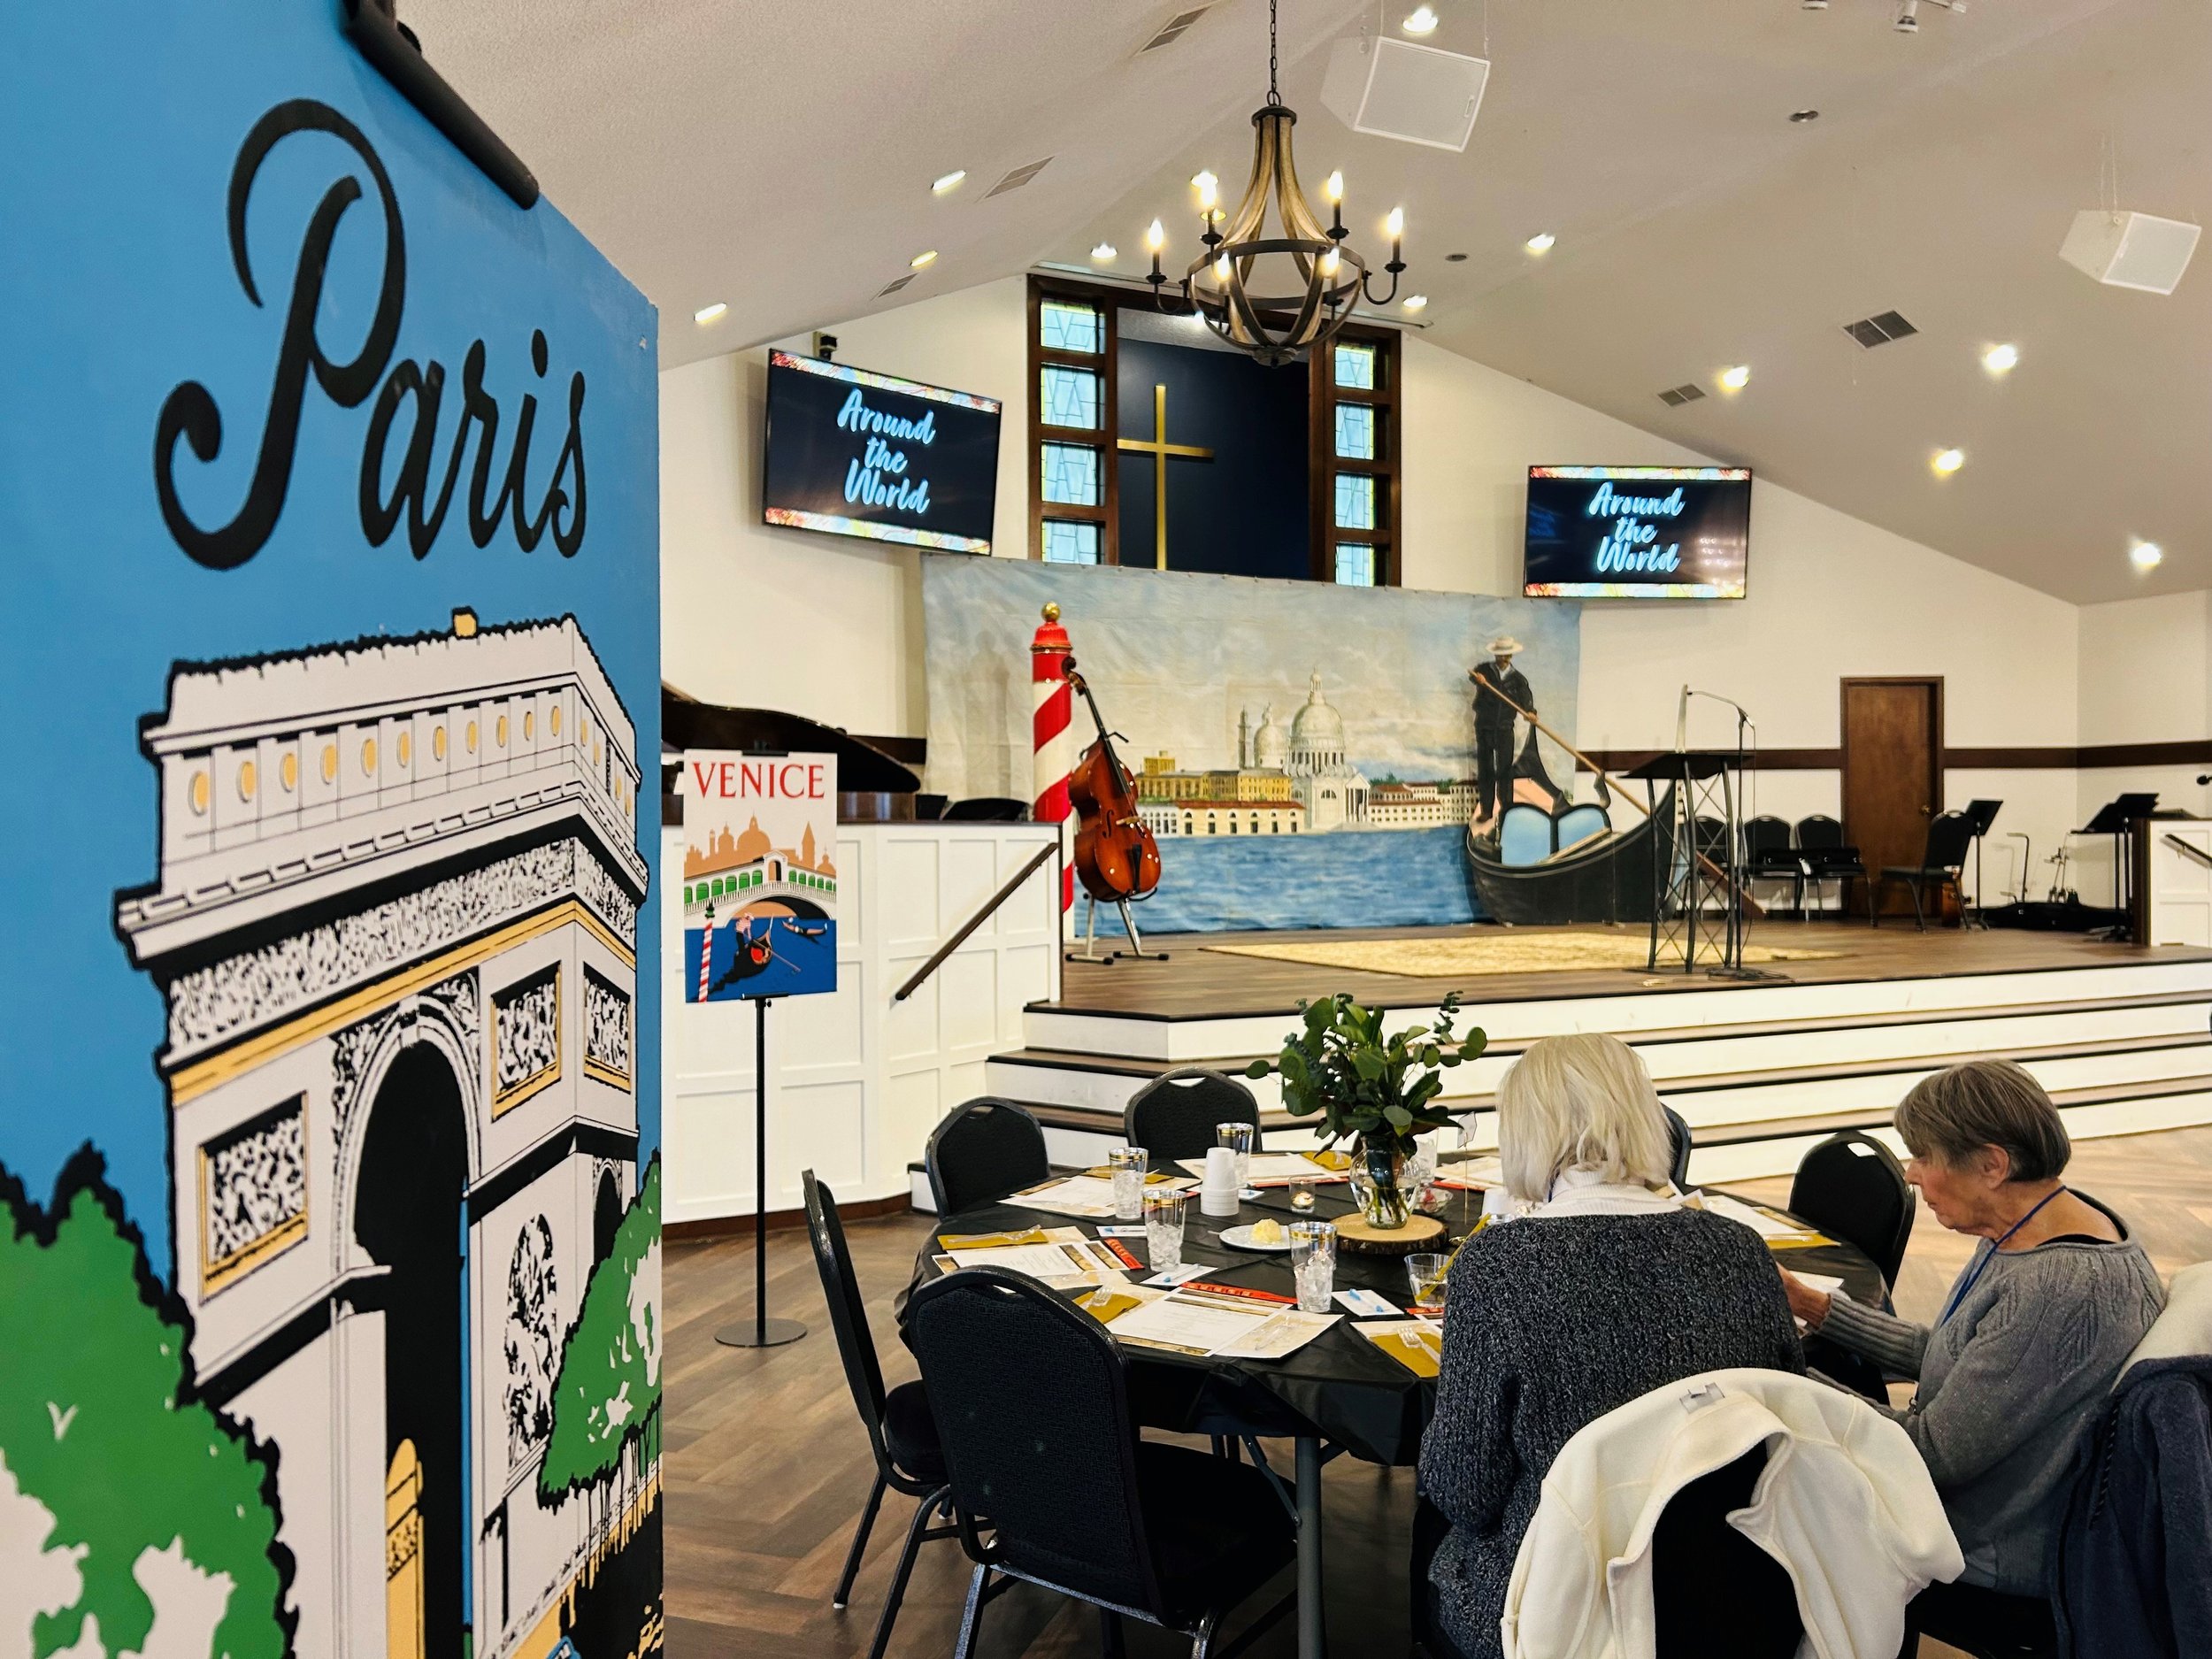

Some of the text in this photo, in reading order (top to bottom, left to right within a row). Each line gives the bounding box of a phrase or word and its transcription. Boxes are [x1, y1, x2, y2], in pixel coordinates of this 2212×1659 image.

[153, 98, 586, 571] Paris
[837, 388, 936, 444] Around
[864, 436, 908, 473] the
[844, 458, 930, 514] World
[1589, 481, 1686, 517] Around
[1614, 516, 1657, 543] the
[1596, 536, 1681, 572] World
[693, 761, 825, 799] VENICE
